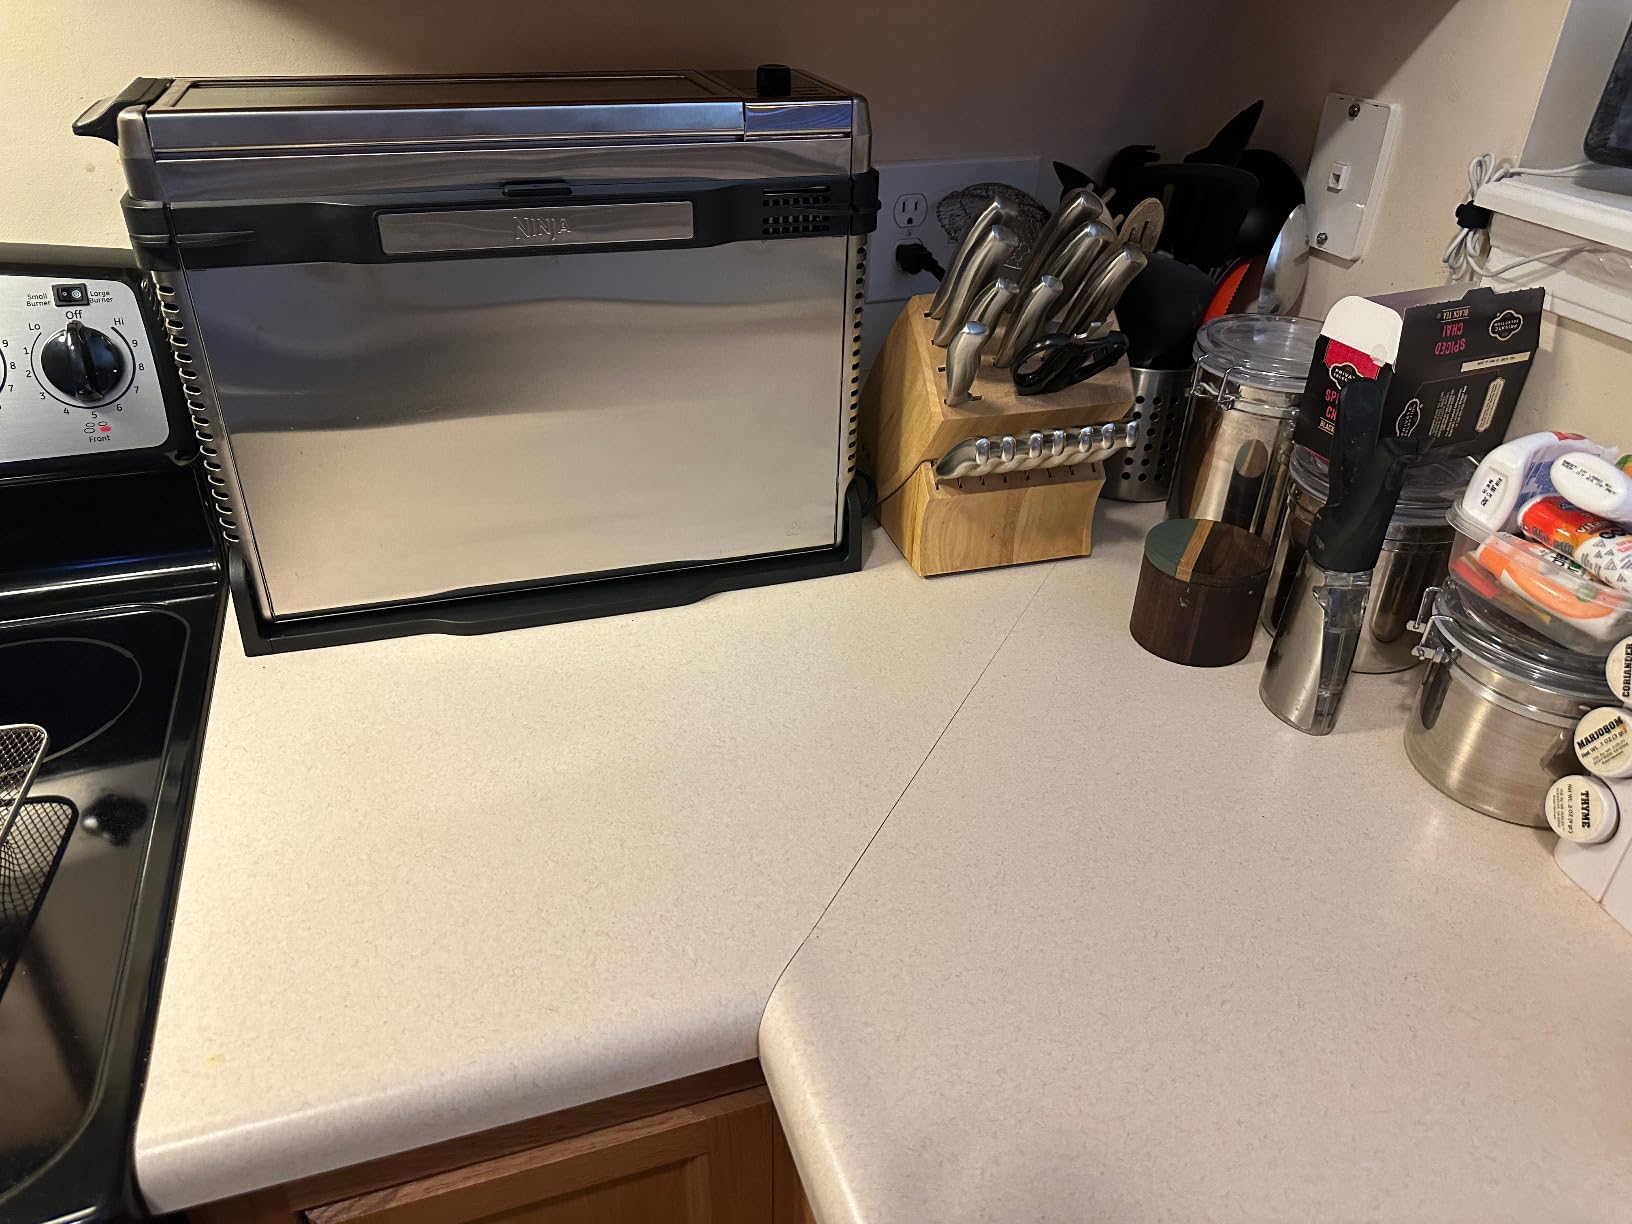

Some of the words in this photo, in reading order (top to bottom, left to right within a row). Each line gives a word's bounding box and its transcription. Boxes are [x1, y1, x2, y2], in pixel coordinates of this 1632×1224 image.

[513, 216, 571, 240] NINJA
[65, 309, 83, 320] Off
[1443, 311, 1452, 320] TEA
[1452, 308, 1469, 318] BLACK
[114, 317, 124, 326] Hi
[28, 322, 41, 331] Lo
[1442, 322, 1464, 338] CHAI
[2, 339, 8, 348] 9
[132, 340, 138, 348] 9
[1434, 338, 1466, 355] SPICED
[10, 362, 16, 370] 8
[26, 370, 32, 378] 2
[40, 392, 46, 400] 3
[1325, 388, 1340, 404] SPI
[92, 411, 98, 419] 5
[1326, 405, 1337, 420] CH
[88, 434, 112, 443] Front
[1622, 643, 1632, 698] CORIANDER
[1580, 790, 1590, 828] THYME
